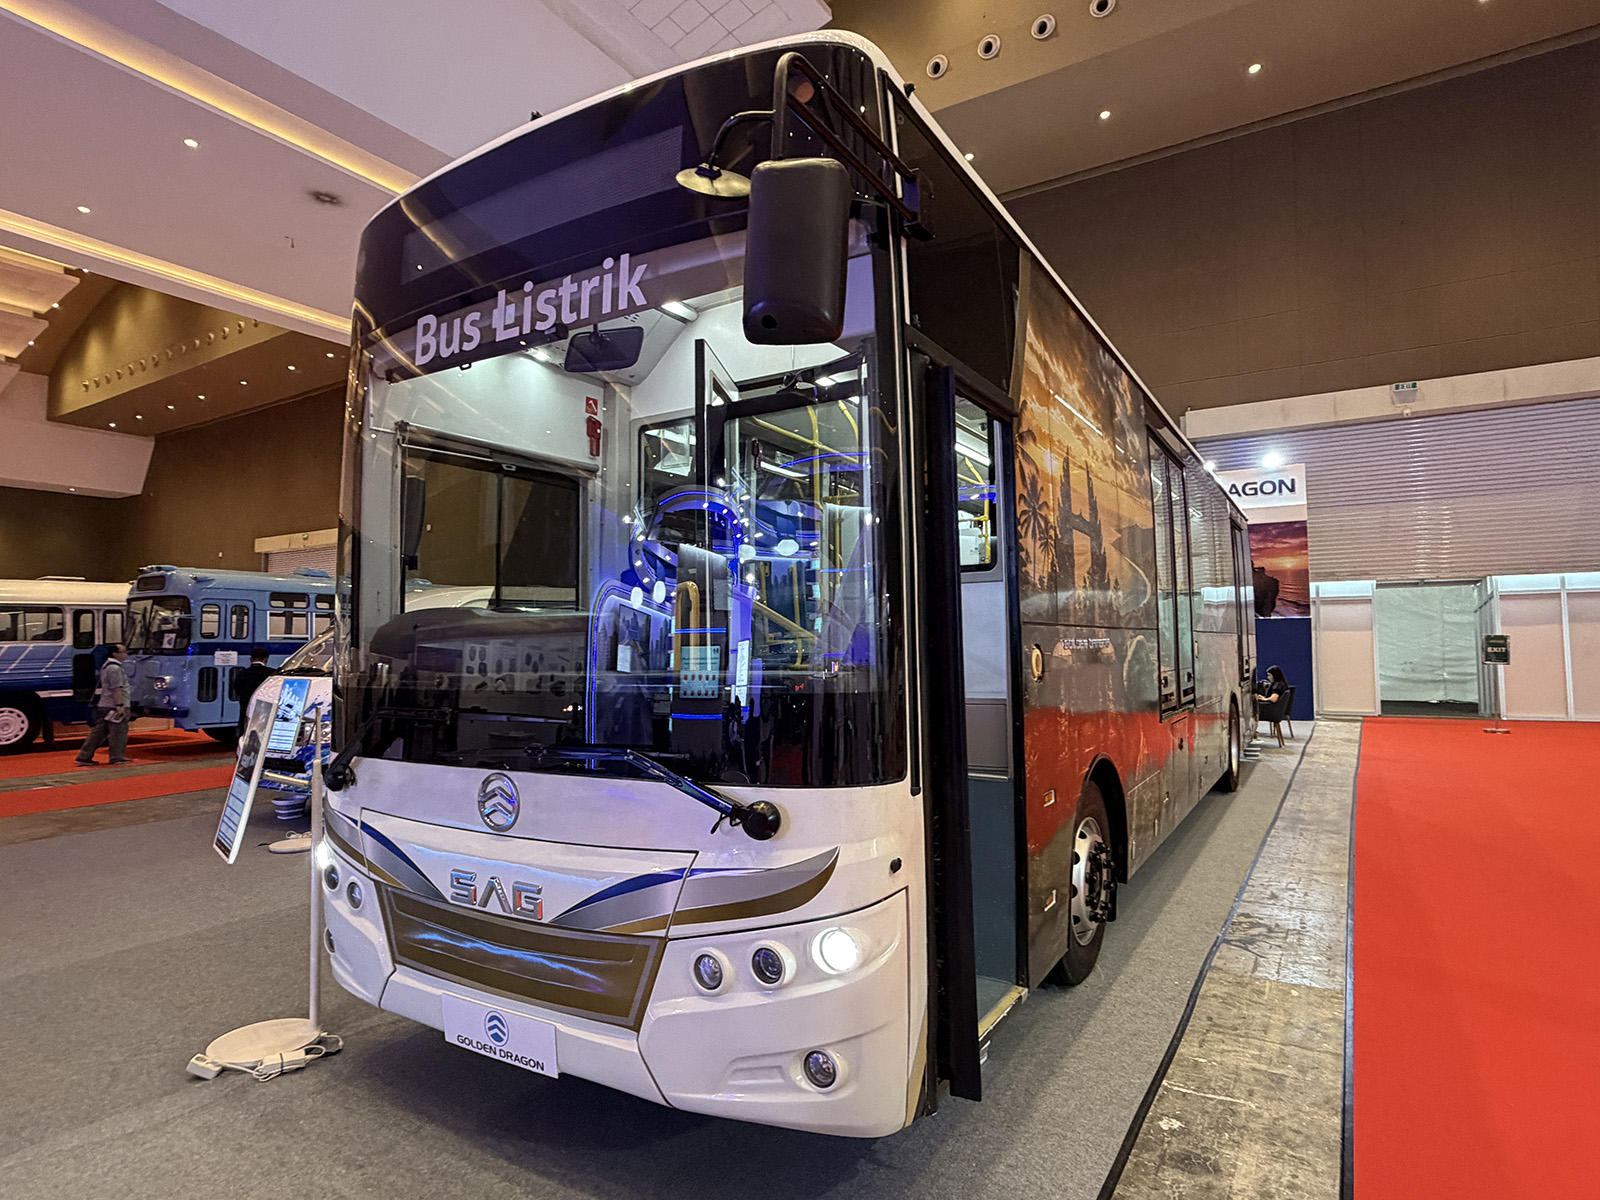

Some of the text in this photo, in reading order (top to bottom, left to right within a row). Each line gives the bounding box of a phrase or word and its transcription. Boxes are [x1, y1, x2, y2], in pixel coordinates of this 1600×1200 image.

[415, 253, 648, 366] Bus Listrik
[1228, 478, 1296, 498] AGON
[450, 868, 543, 920] SAG
[456, 1034, 545, 1072] GOLDEN DRAGON
